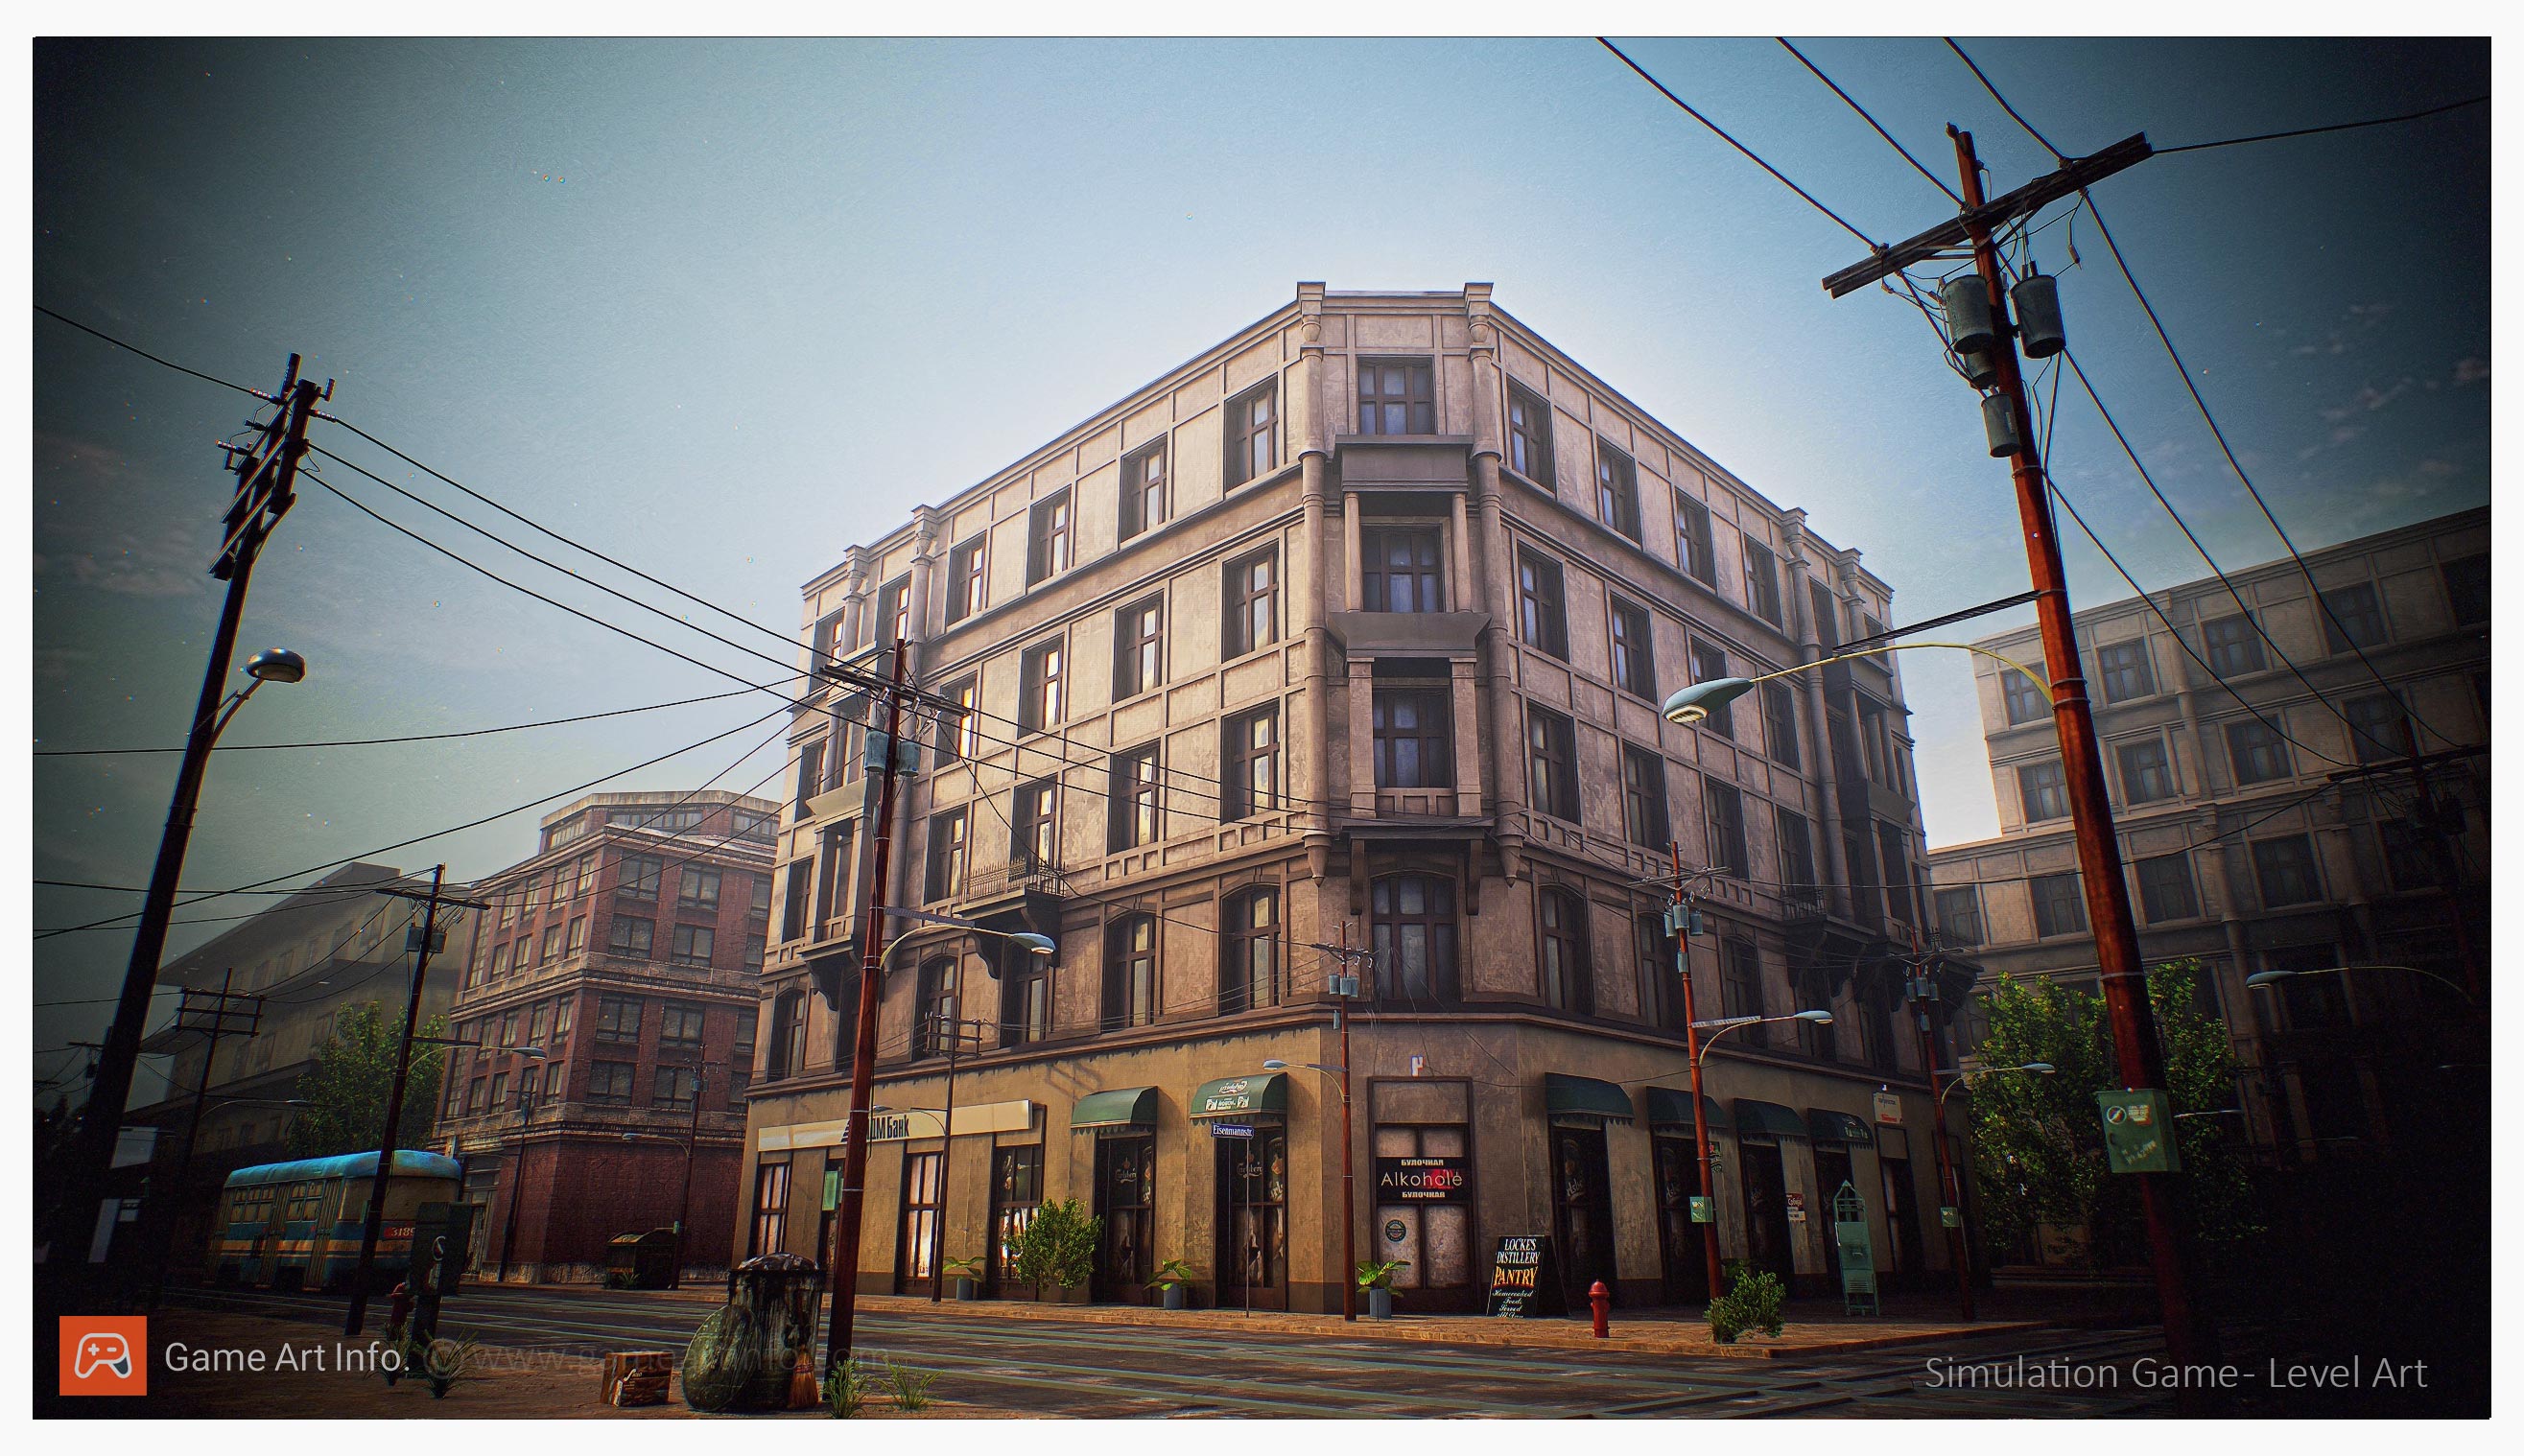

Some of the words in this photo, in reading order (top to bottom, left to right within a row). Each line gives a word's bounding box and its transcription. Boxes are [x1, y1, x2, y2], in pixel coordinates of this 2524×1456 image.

[887, 1115, 909, 1139] Банк
[1497, 1252, 1540, 1264] DISTILLERY
[1493, 1266, 1538, 1286] PANTRY
